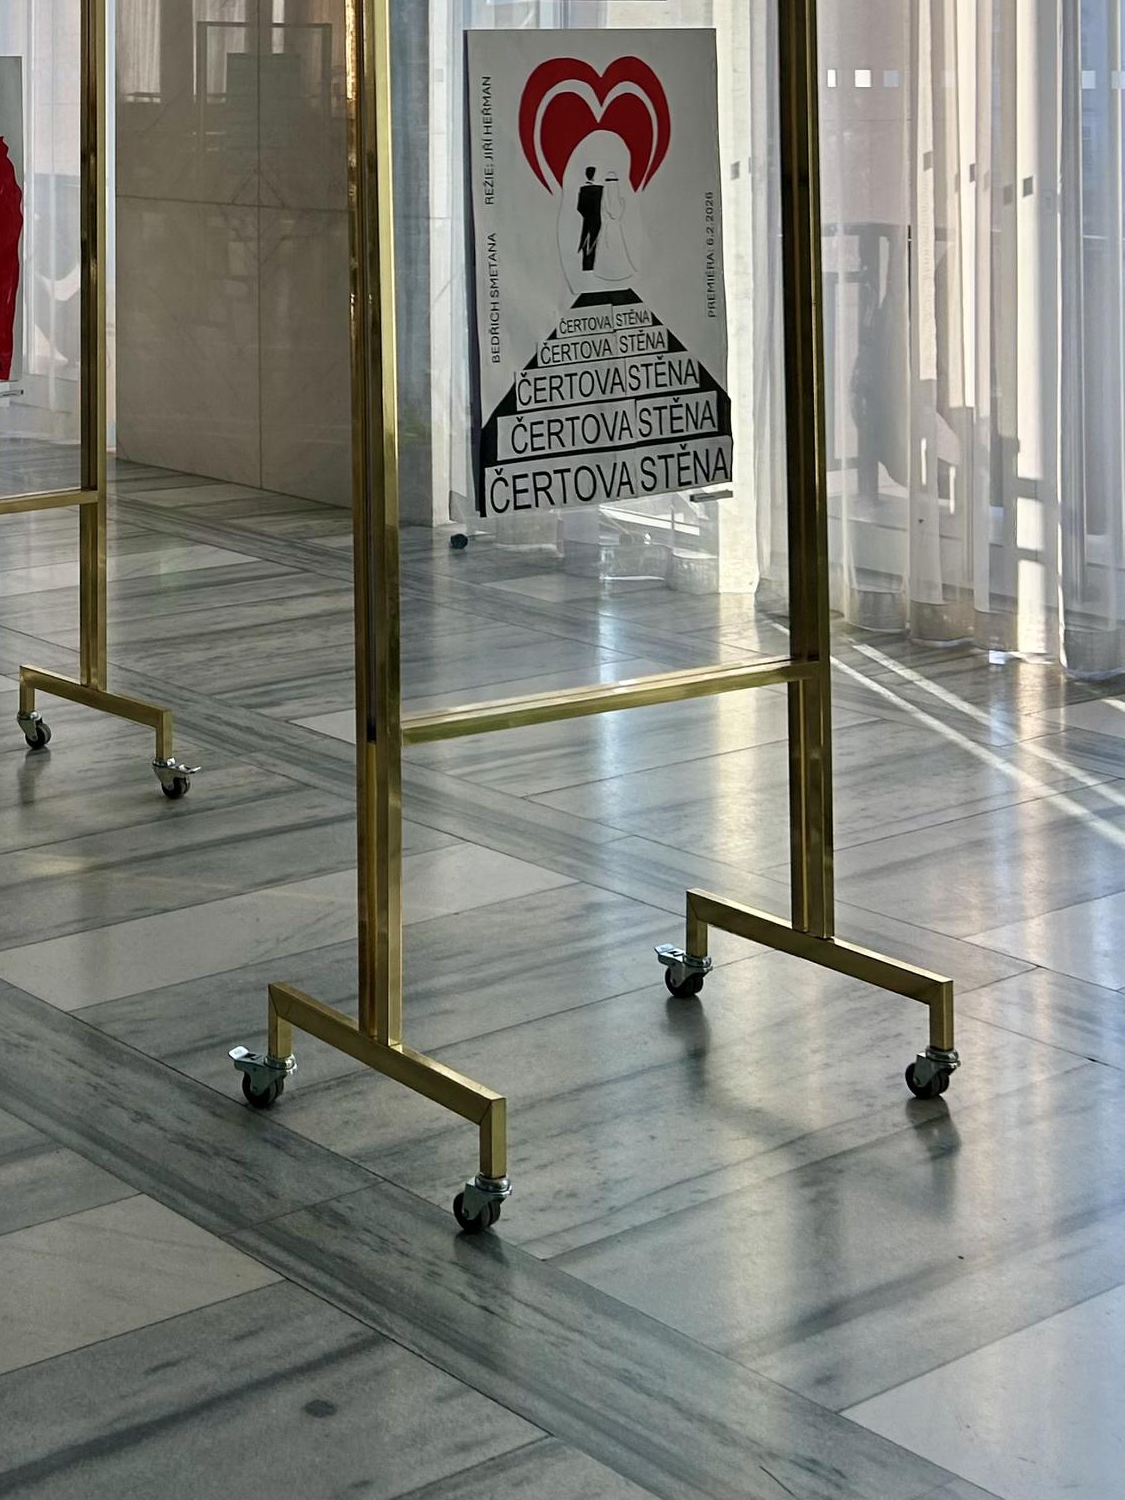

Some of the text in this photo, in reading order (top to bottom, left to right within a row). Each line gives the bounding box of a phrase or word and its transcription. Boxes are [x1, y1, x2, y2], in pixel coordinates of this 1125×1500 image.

[481, 76, 492, 134] HEŘMAN
[482, 136, 493, 160] JIŘÍ
[488, 232, 500, 363] BEDŘICH SMETANA
[559, 309, 650, 335] ČERTOVA STĚNA
[540, 330, 665, 364] ČERTOVA STĚNA
[517, 355, 699, 406] ČERTOVA STĚNA
[511, 397, 716, 454] ČERTOVA STĚNA
[490, 443, 728, 513] ČERTOVA STĚNA
